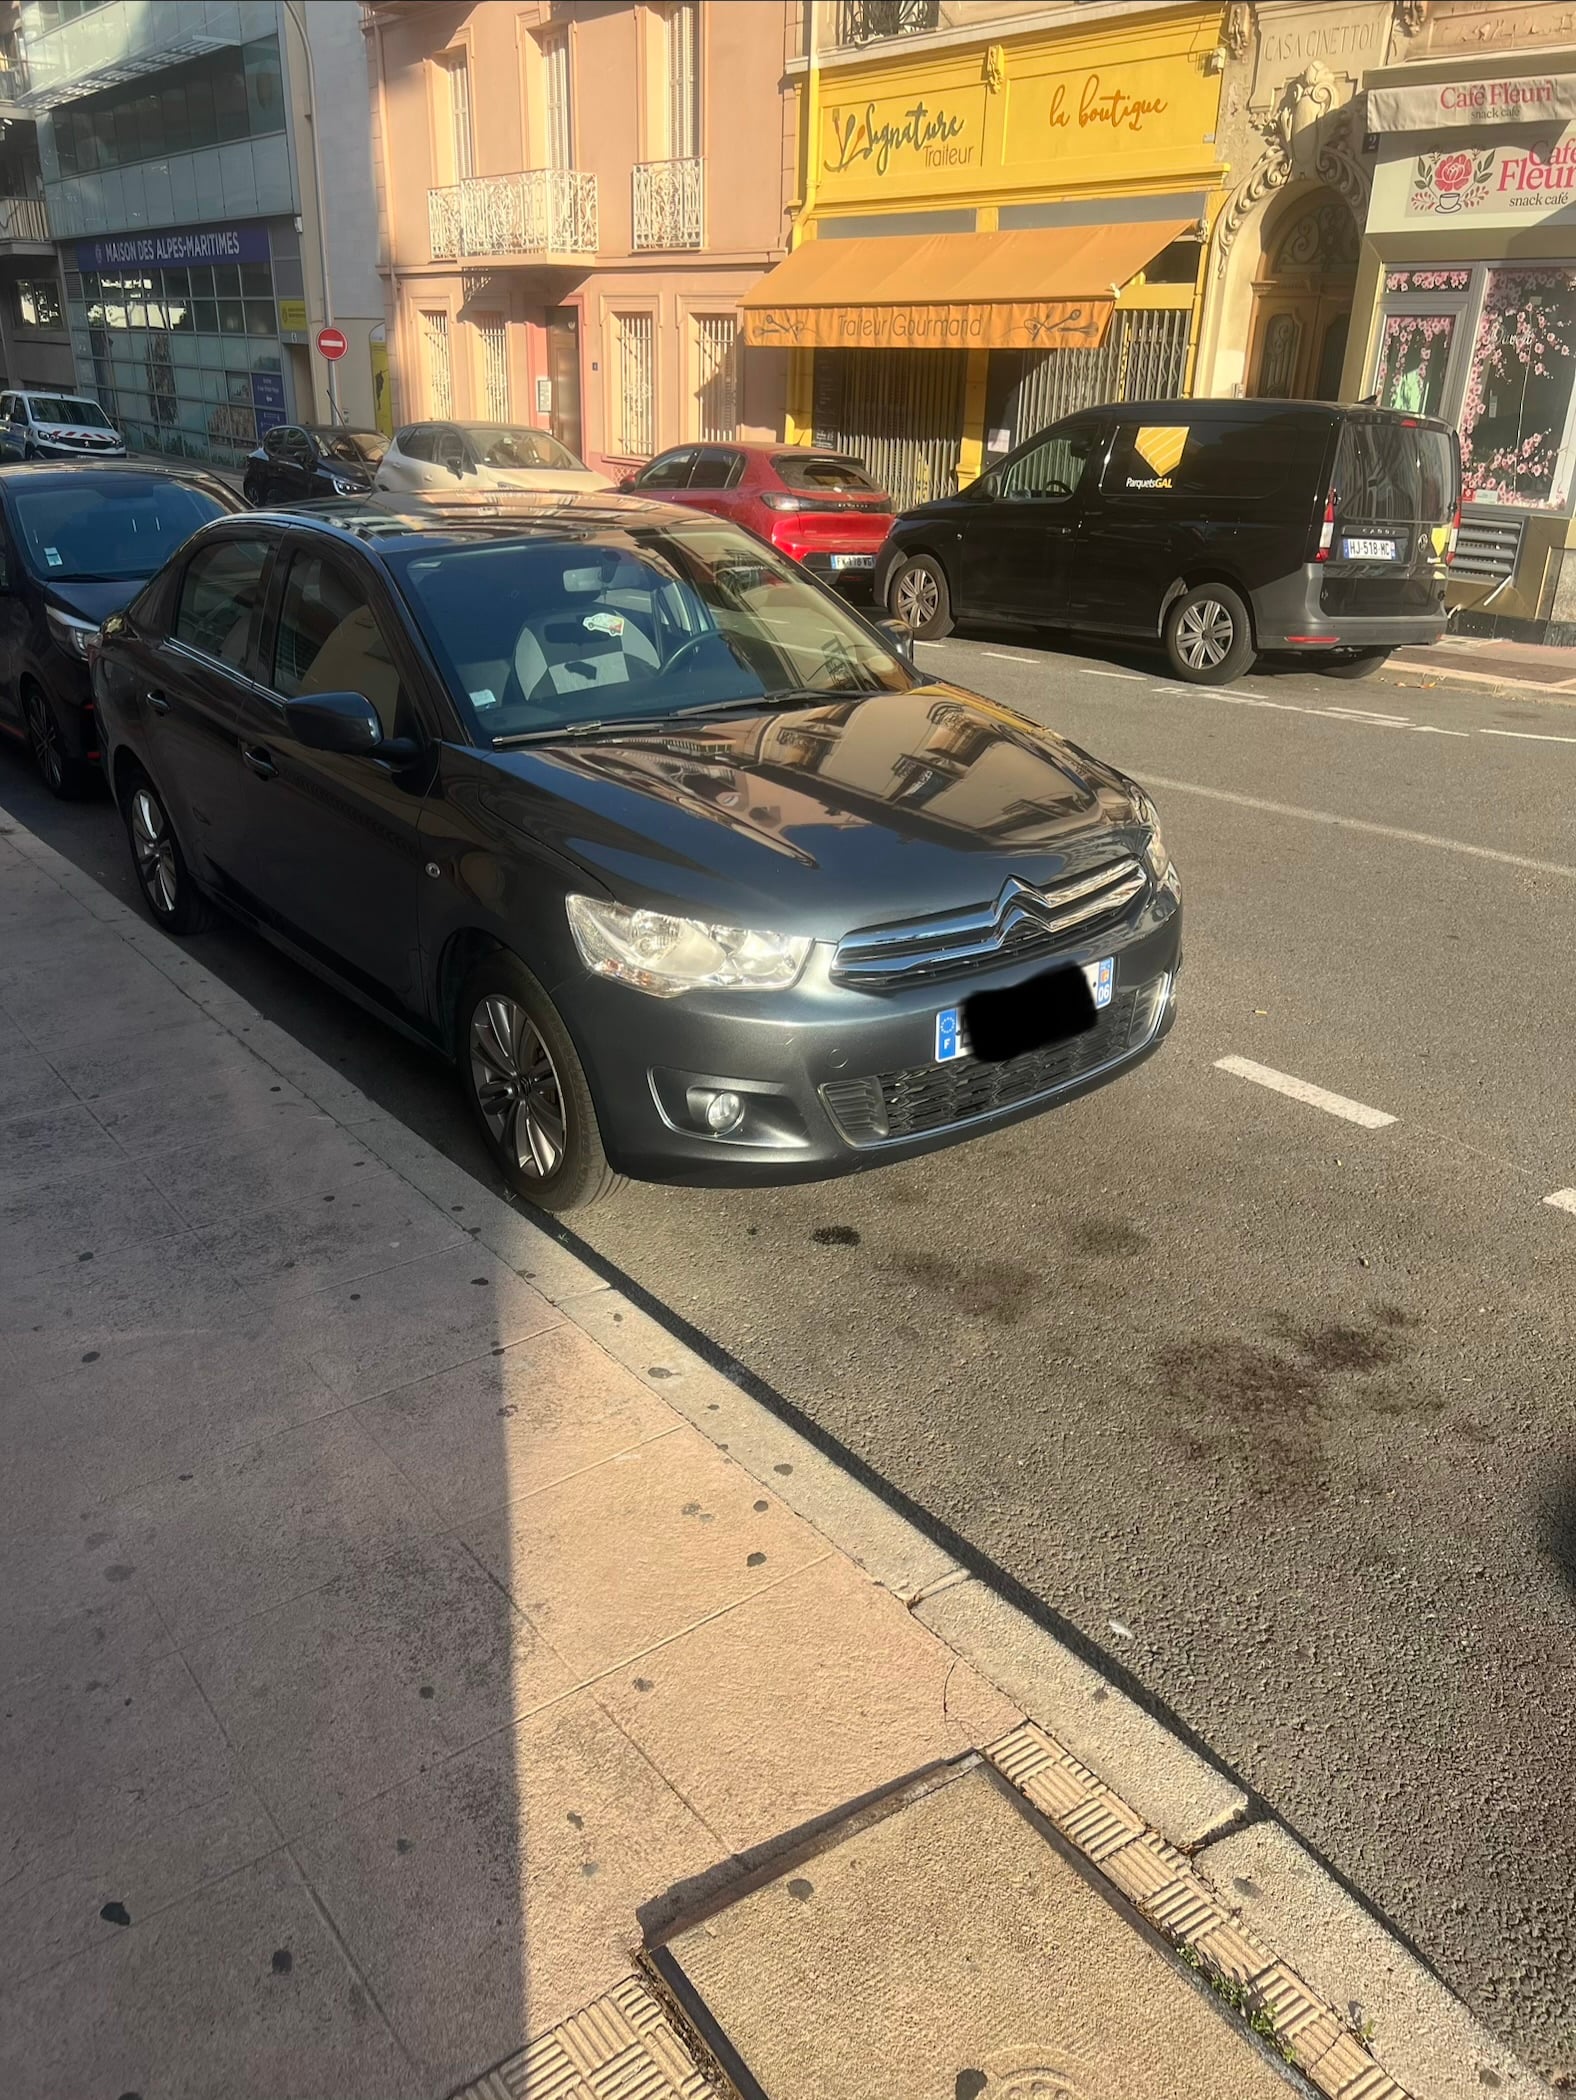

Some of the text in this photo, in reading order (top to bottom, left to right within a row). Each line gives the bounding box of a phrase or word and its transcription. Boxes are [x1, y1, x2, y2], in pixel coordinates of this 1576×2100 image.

[1264, 32, 1300, 61] CASA
[1049, 74, 1168, 131] la boutique
[1440, 79, 1553, 110] Café Fleuri
[1471, 105, 1520, 120] snack café
[863, 101, 965, 177] Signature
[1368, 134, 1377, 150] 2
[922, 145, 975, 169] Traiteur
[1508, 191, 1569, 208] snack café
[105, 231, 240, 263] MAISON DES ALPES-MARITIMES
[838, 312, 983, 337] Traiteur Gourmand
[1098, 984, 1111, 1003] 06
[943, 1038, 951, 1050] F
